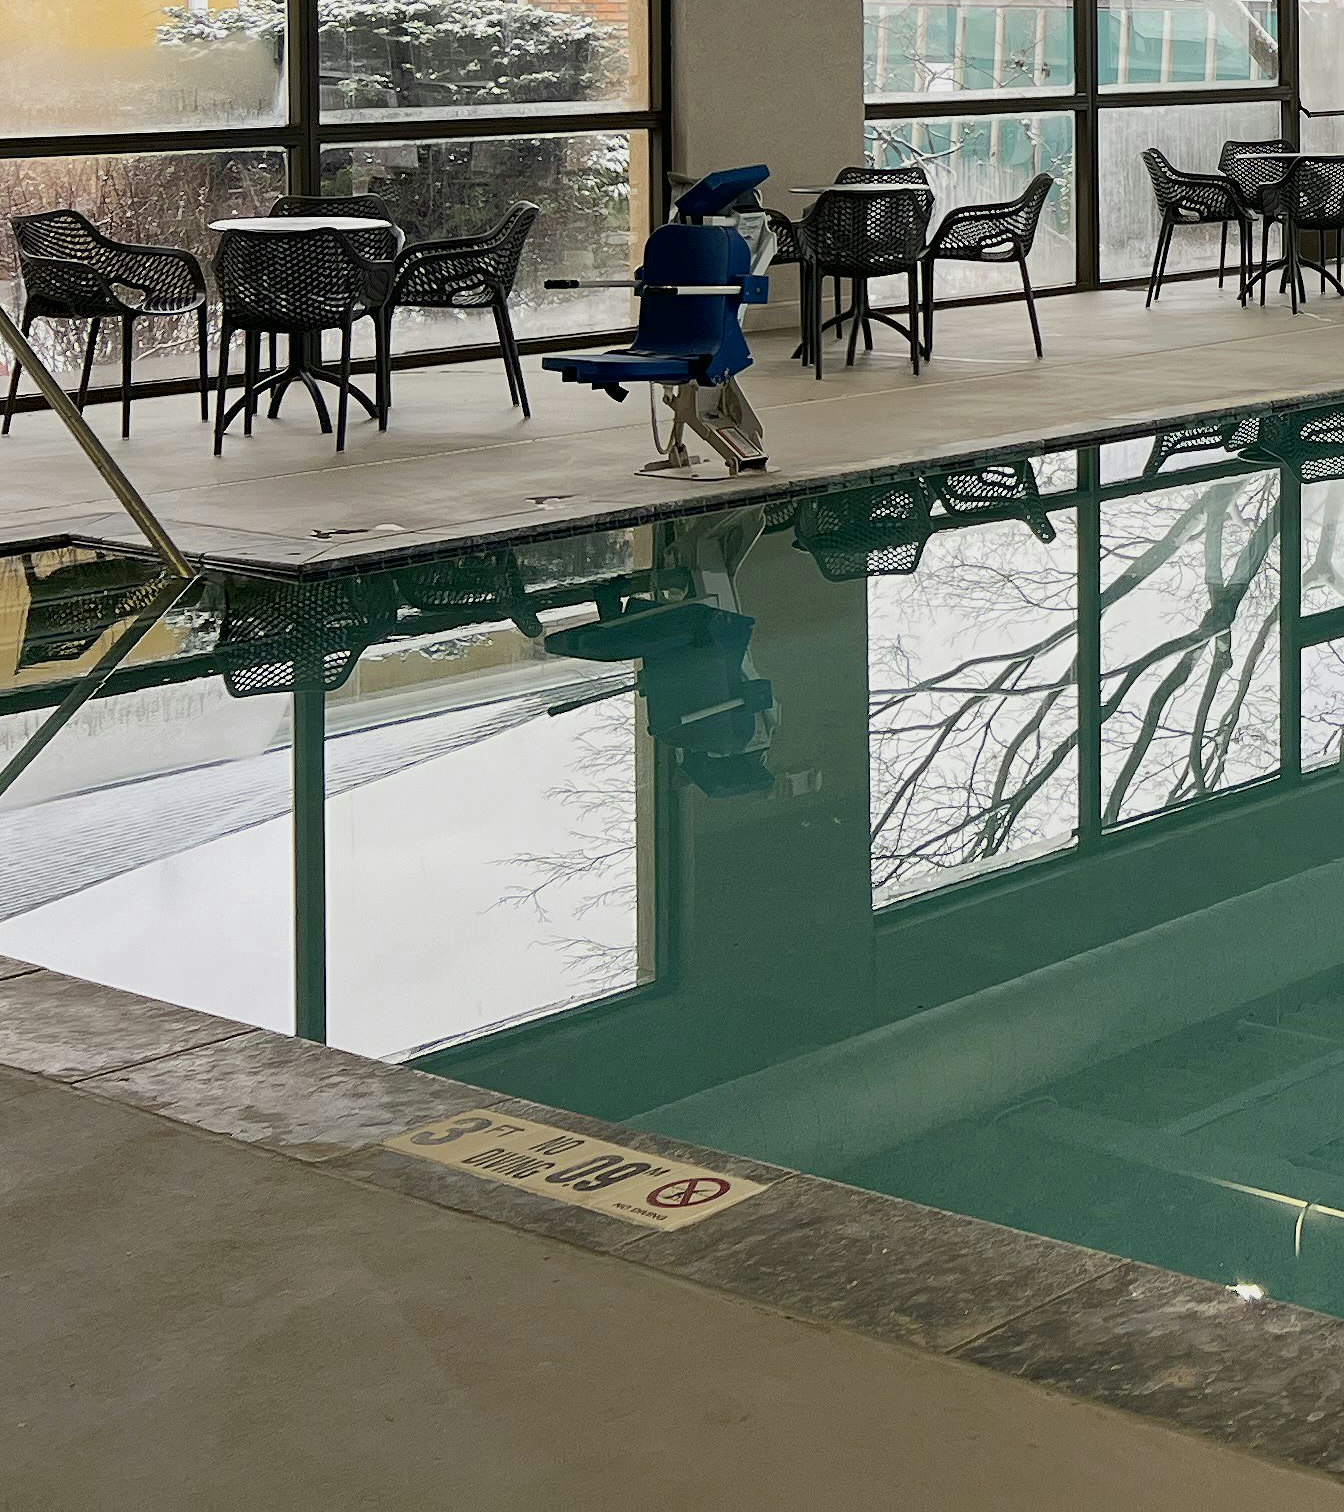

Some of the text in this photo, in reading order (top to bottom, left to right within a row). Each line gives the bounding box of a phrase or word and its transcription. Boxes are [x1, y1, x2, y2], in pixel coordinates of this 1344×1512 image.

[410, 1117, 525, 1146] 3 FT
[528, 1135, 585, 1156] NO
[461, 1148, 555, 1179] DIVING
[545, 1154, 671, 1191] 0.9 M
[612, 1202, 632, 1211] NO
